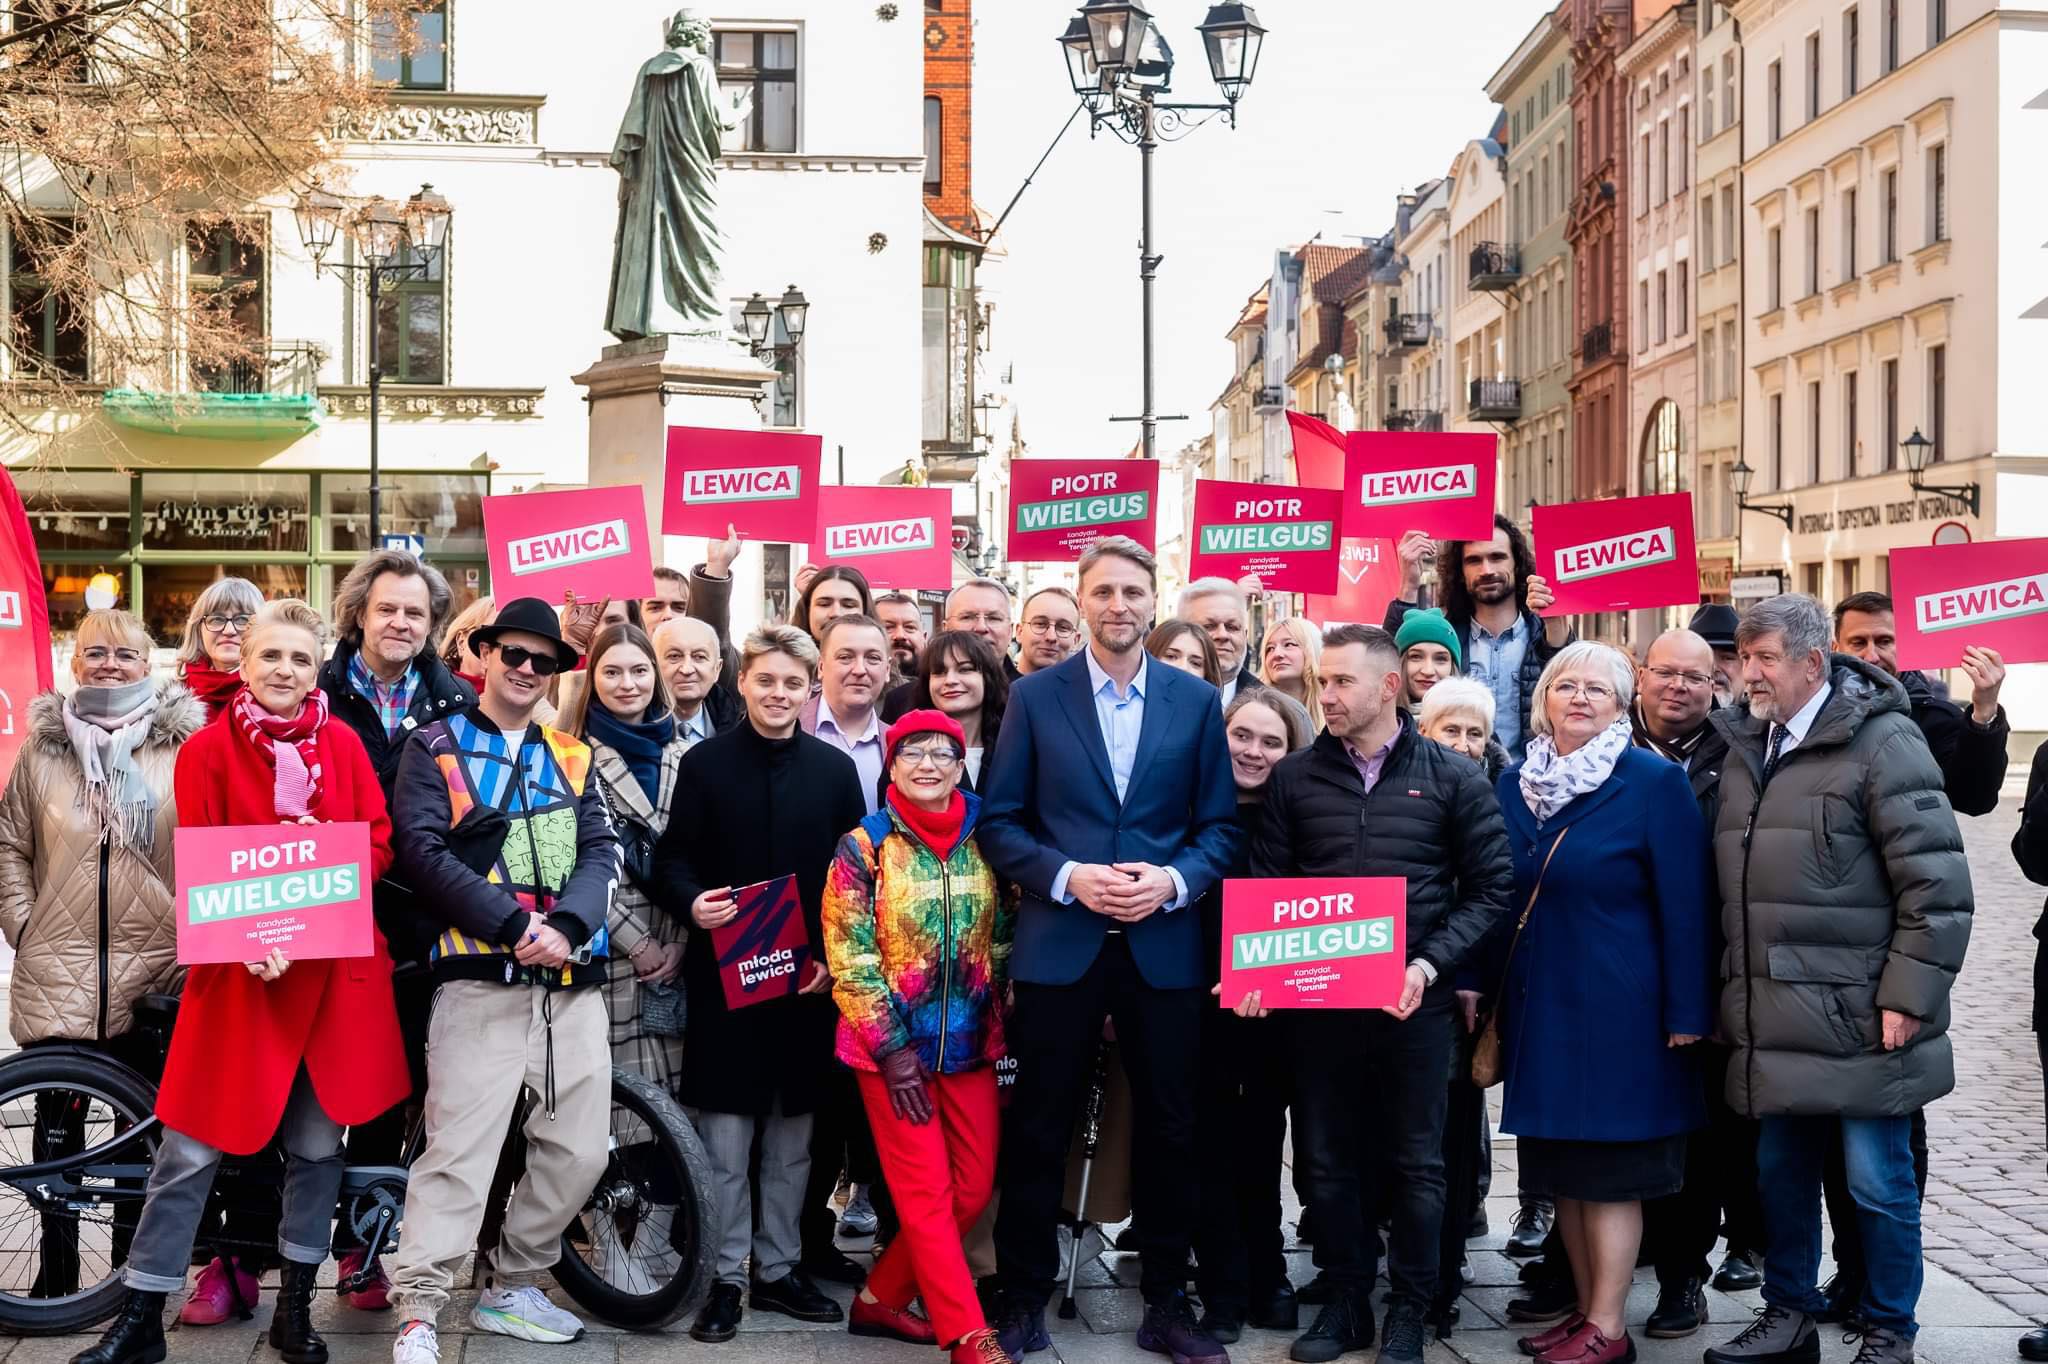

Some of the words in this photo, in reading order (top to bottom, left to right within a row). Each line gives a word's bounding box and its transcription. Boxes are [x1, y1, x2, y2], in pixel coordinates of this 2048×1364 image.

[690, 471, 791, 496] LEWICA
[1051, 471, 1118, 496] PIOTR
[1368, 470, 1467, 497] LEWICA
[158, 500, 229, 524] flying
[237, 500, 298, 525] tiger
[1022, 495, 1143, 528] WIELGUS
[1235, 498, 1302, 519] PIOTR
[1885, 501, 1915, 524] TOURIST
[516, 526, 620, 566] LEWICA
[832, 522, 926, 550] LEWICA
[1206, 524, 1327, 550] WIELGUS
[1562, 533, 1666, 574] LEWICA
[1924, 581, 2045, 623] LEWICA
[231, 839, 317, 874] PIOTR
[195, 869, 353, 918] WIELGUS
[1273, 892, 1354, 923] PIOTR
[246, 931, 257, 939] na
[259, 924, 306, 939] prezydenta
[256, 917, 295, 928] Kandydat
[261, 934, 293, 945] Torunia
[1239, 922, 1388, 964] WIELGUS
[737, 948, 793, 973] młoda
[1294, 966, 1331, 977] Kandydat
[740, 962, 796, 986] lewica
[1296, 973, 1341, 987] prezydenta
[1297, 982, 1328, 992] Torunia
